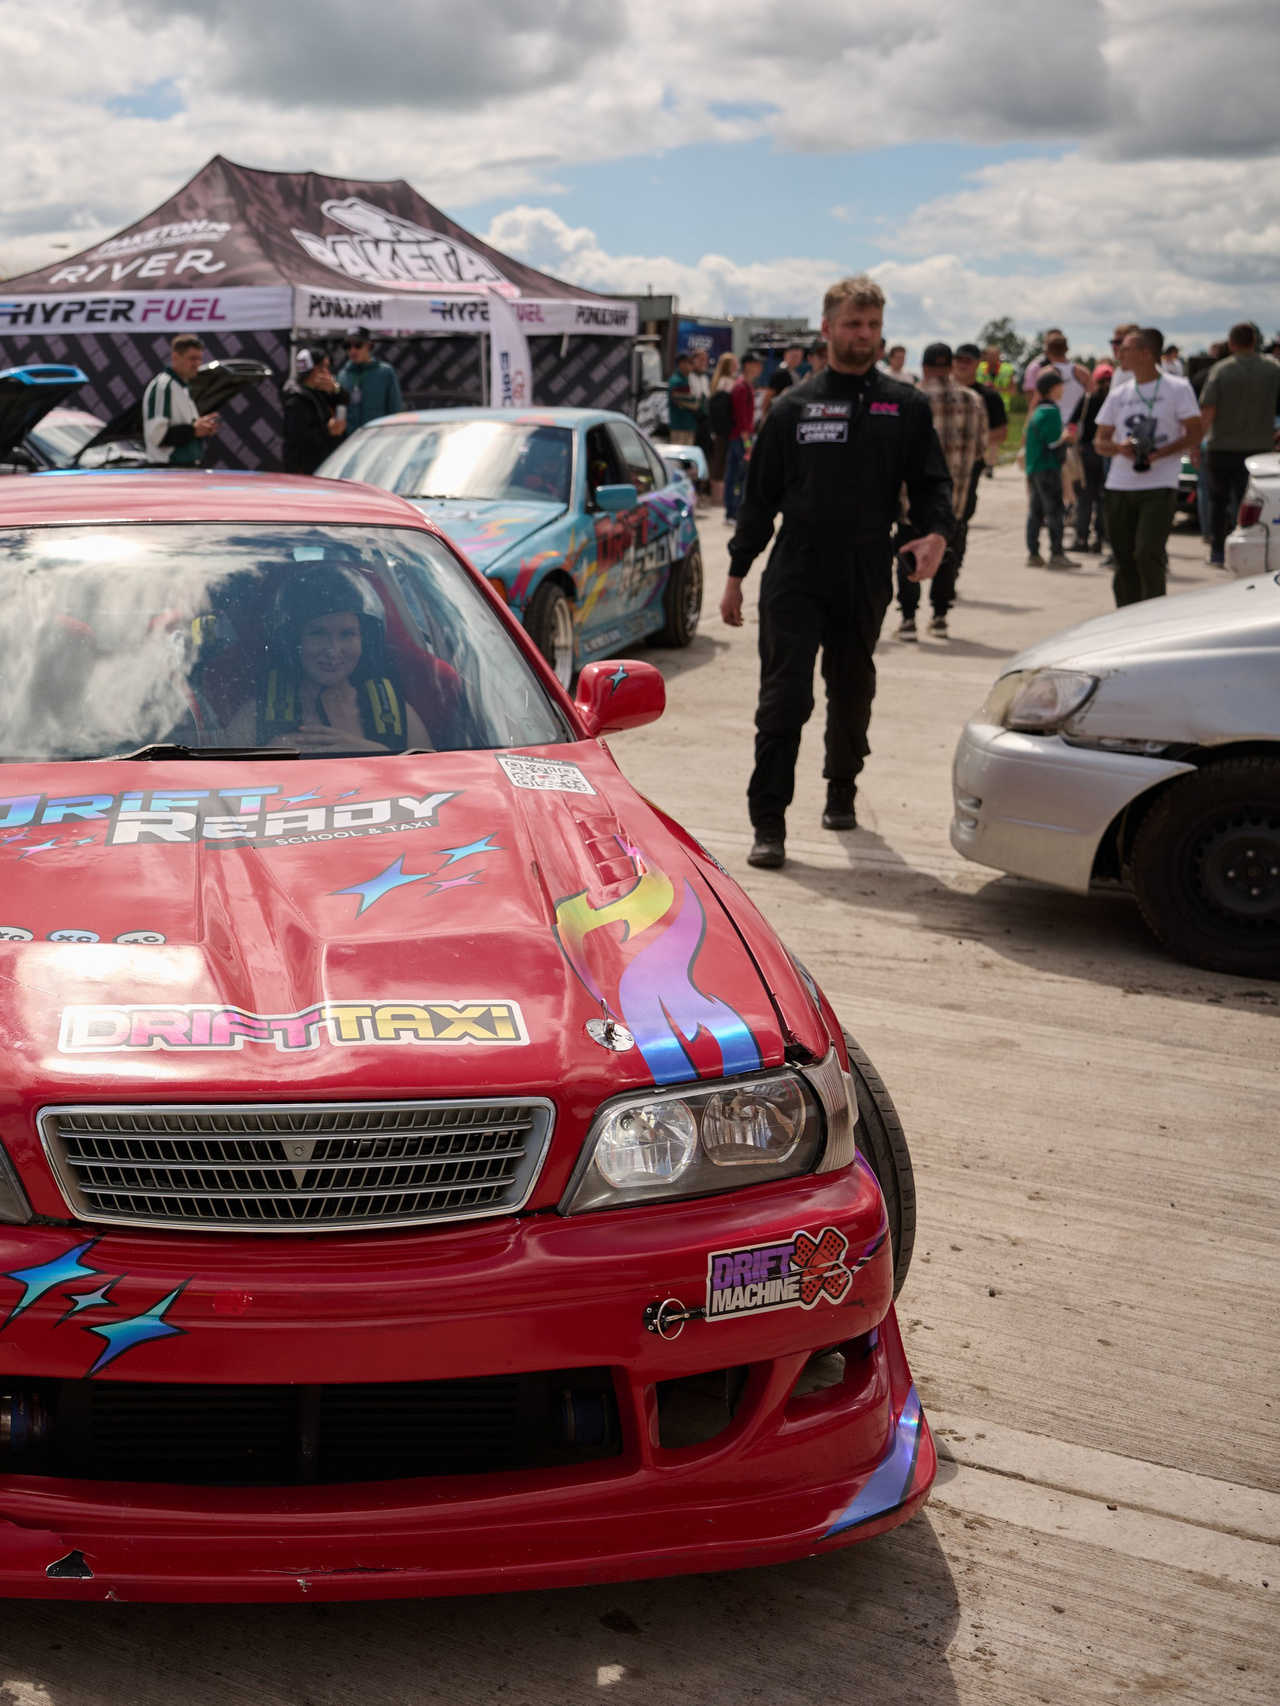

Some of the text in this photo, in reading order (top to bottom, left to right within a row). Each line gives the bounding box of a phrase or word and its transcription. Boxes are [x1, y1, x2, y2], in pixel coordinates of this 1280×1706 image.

[48, 248, 228, 285] RIVER
[141, 298, 227, 322] FUEL
[434, 300, 545, 323] HYPE UEL
[533, 757, 563, 765] READY
[111, 792, 457, 845] READY
[275, 819, 433, 846] SCHOOL & TAXI
[70, 1007, 320, 1047] DRIFT
[712, 1244, 795, 1291] DRIFT
[711, 1275, 801, 1314] MACHINE
